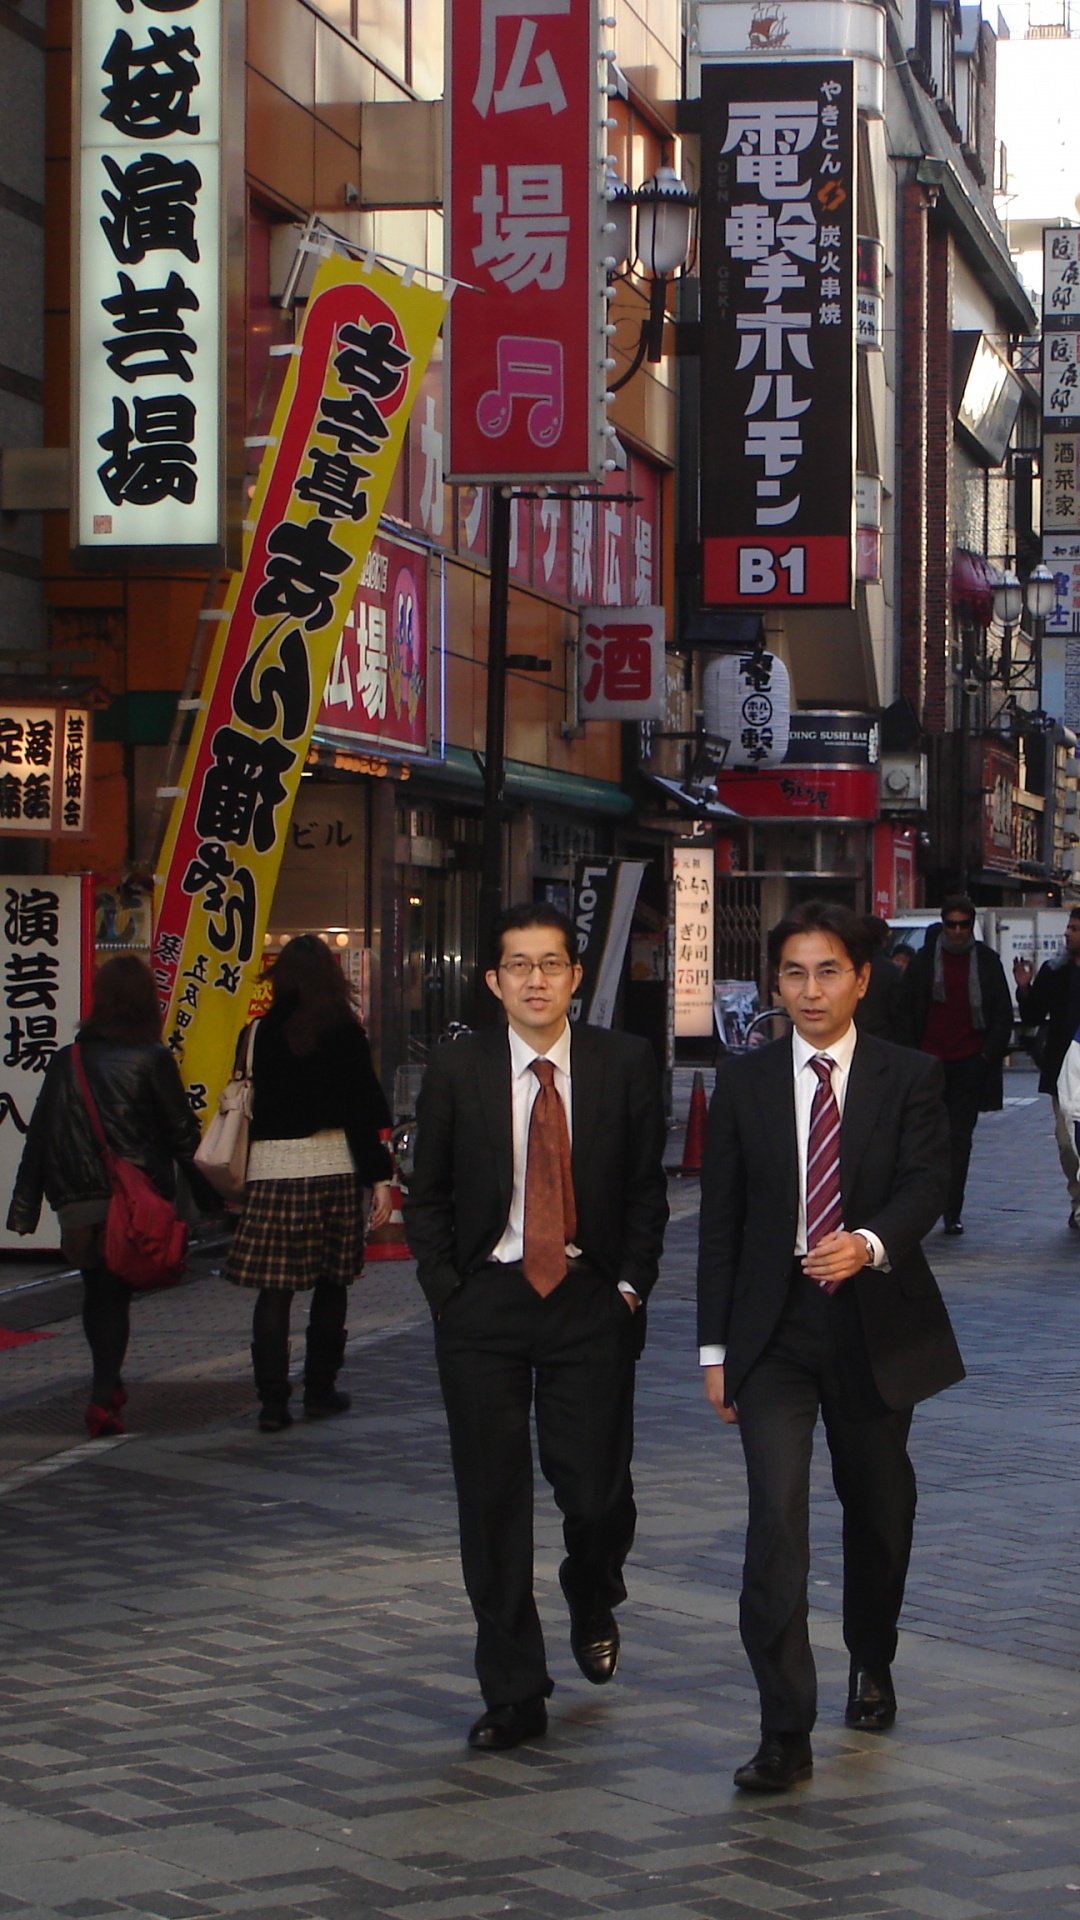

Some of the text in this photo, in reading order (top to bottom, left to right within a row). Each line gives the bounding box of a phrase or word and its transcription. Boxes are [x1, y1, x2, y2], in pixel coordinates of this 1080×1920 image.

[472, 0, 571, 293] 広場
[819, 80, 843, 174] やきとん
[97, 0, 202, 507] 袋演芸場
[819, 225, 843, 325] 炭火串焼
[1054, 442, 1075, 517] 酒菜家
[738, 547, 806, 595] B1
[584, 623, 653, 704] 酒
[820, 731, 850, 740] SUSHI
[4, 887, 60, 1074] 演芸場
